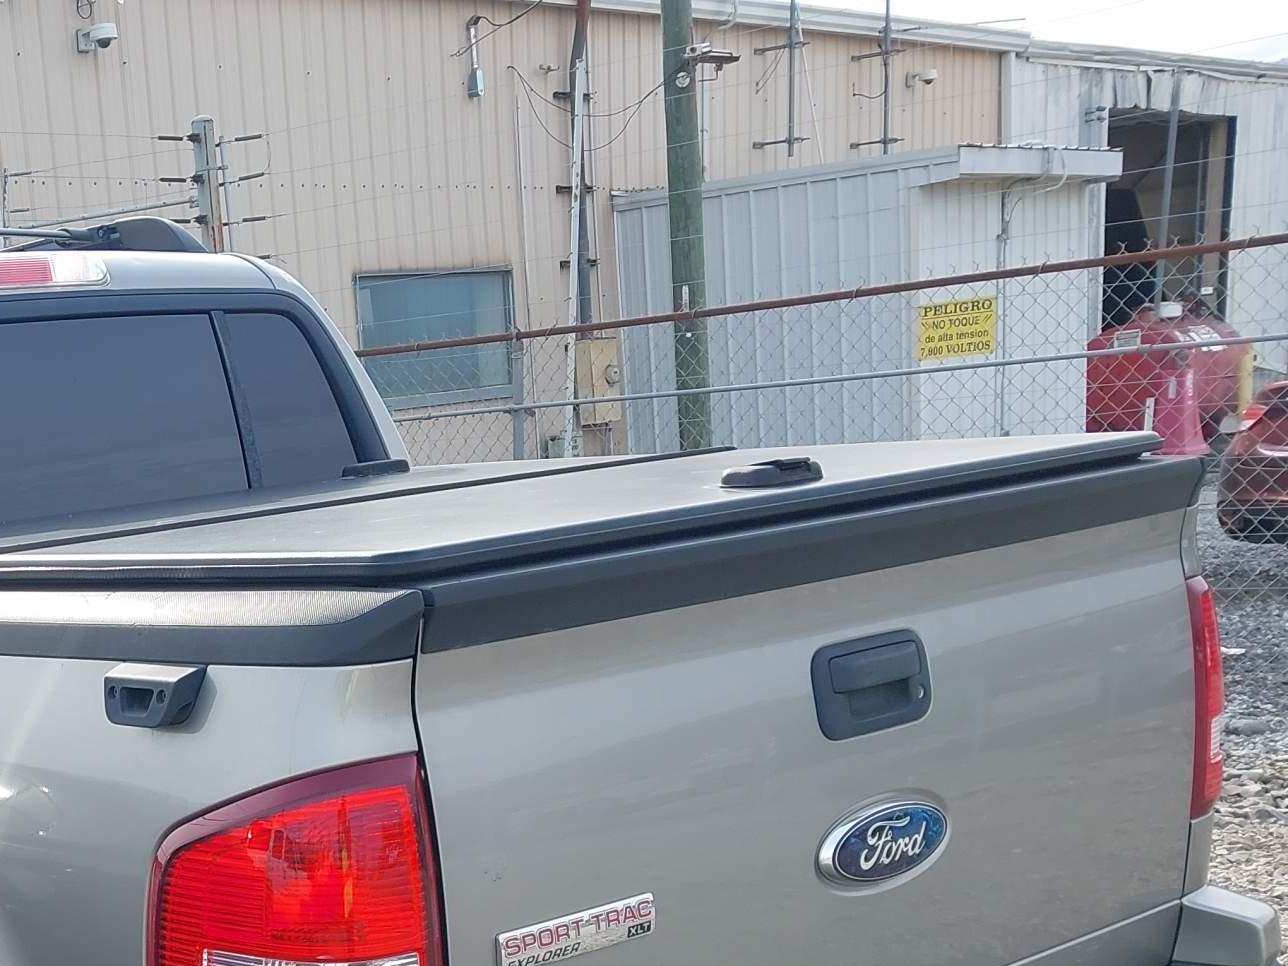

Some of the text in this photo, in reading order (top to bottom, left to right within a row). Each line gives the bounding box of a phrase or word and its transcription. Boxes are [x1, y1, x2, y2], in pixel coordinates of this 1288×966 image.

[923, 298, 993, 317] PELIGRO
[932, 315, 981, 330] NO TOQUE
[925, 328, 990, 344] de alta tension
[945, 340, 991, 354] VOLTIOS
[860, 813, 926, 870] Ford
[503, 898, 653, 958] SPORT TRAC
[629, 923, 651, 937] XLT
